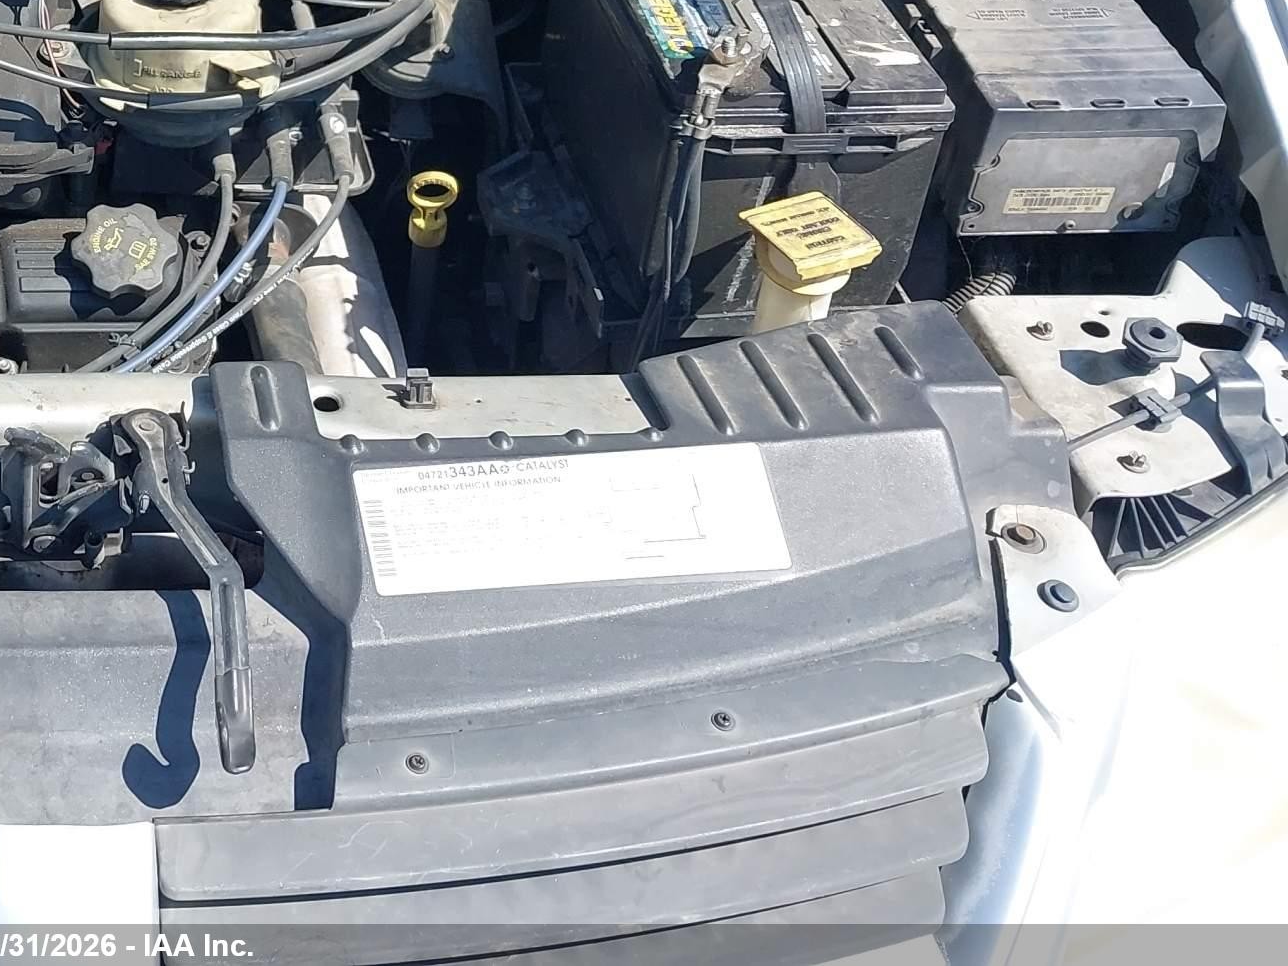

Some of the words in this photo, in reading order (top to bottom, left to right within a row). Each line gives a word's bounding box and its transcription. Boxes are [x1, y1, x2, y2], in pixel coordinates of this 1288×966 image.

[159, 68, 201, 79] RANGE
[92, 225, 106, 254] ENGINE
[103, 217, 118, 228] OIL
[134, 257, 151, 271] SAE
[170, 335, 208, 362] Suppression
[515, 459, 570, 473] CATALYST
[396, 483, 451, 496] IMPORTANT
[455, 481, 491, 491] VEHICLE
[493, 476, 562, 489] INFORMATION
